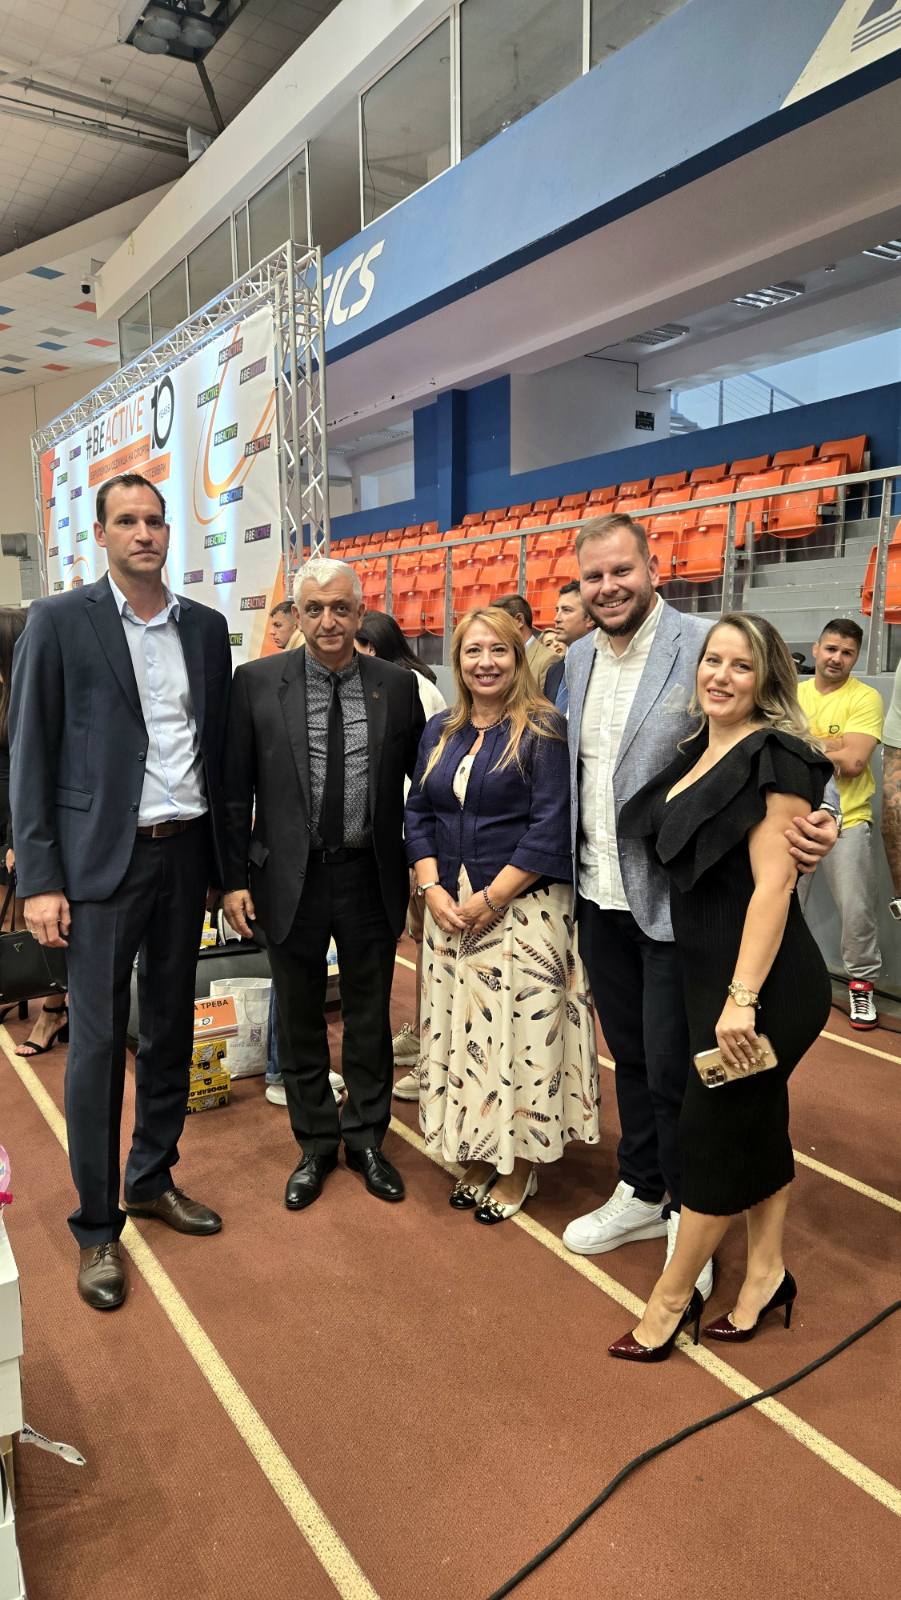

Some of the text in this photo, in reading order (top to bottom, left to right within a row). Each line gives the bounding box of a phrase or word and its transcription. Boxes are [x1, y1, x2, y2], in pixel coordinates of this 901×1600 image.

[300, 239, 385, 335] ICS
[151, 375, 174, 449] 10
[86, 395, 144, 460] #BEACTIVE
[214, 423, 238, 446] #BEACTIVE
[245, 434, 271, 456] #BEACTIVE
[245, 525, 271, 542] #BEACTIVE
[241, 596, 265, 609] #BEACTIVE
[230, 634, 242, 645] CTIVE
[200, 1000, 228, 1010] ТРЕВА
